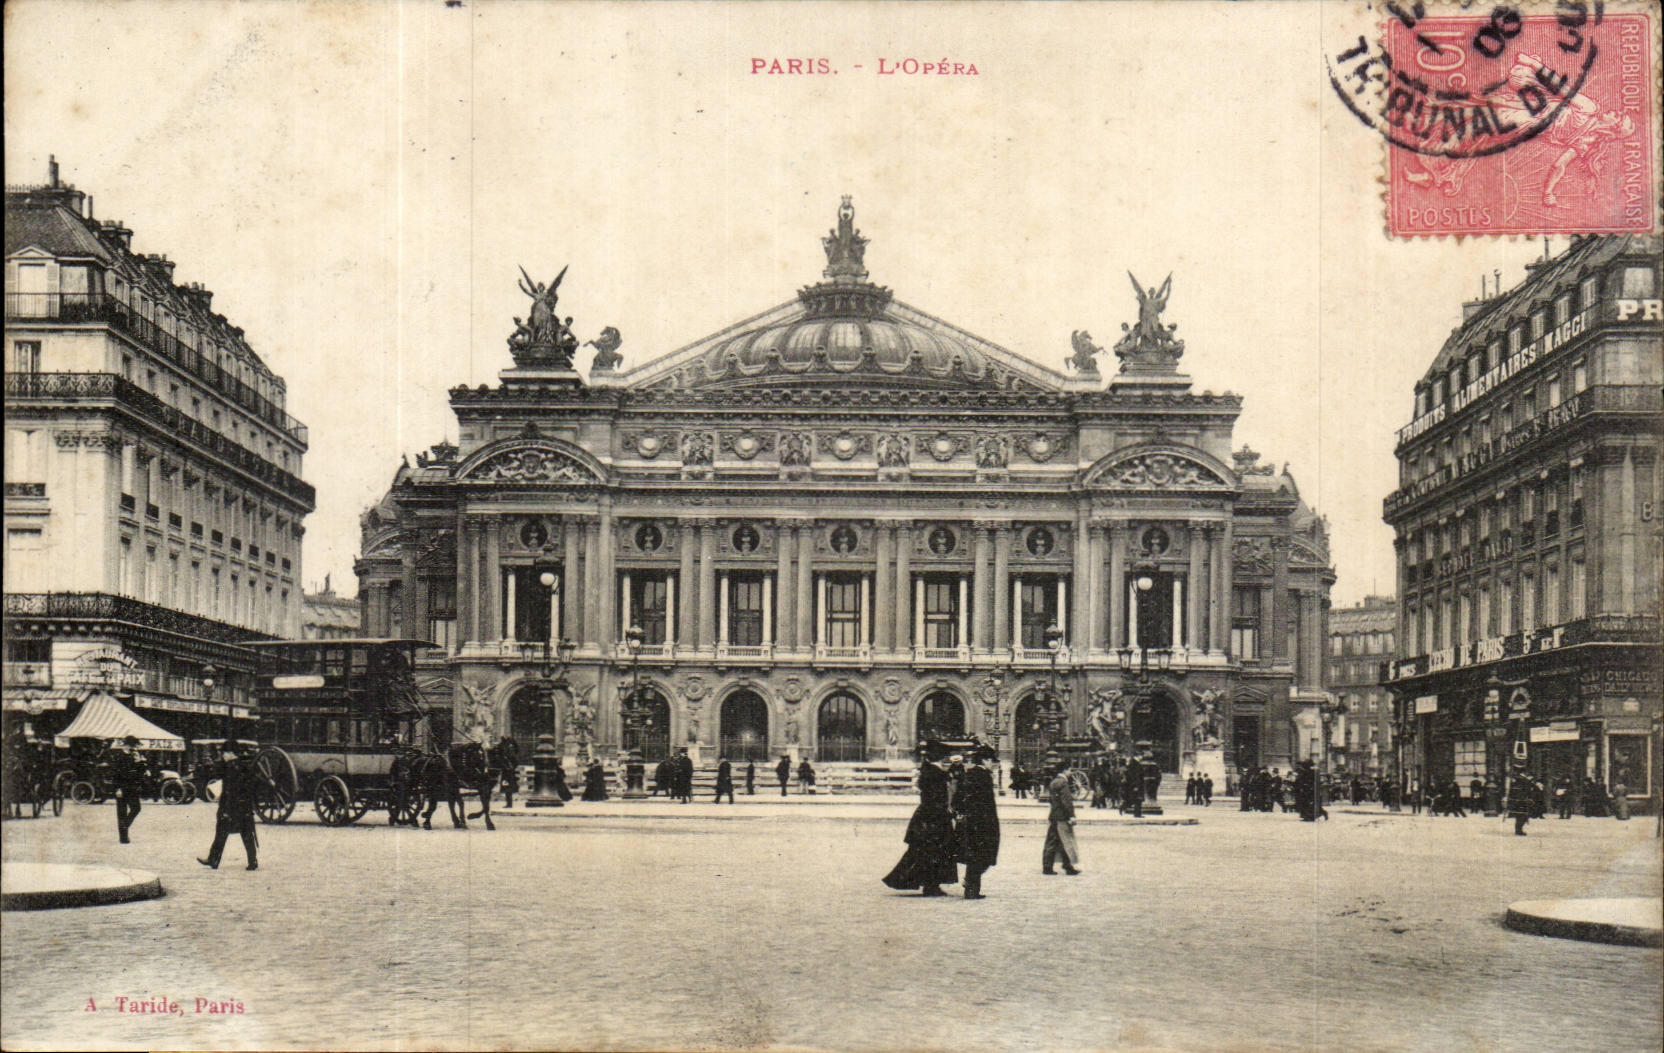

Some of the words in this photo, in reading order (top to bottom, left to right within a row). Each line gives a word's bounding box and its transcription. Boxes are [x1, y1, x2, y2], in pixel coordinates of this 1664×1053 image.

[1621, 23, 1640, 113] REPUBLIQUE
[1518, 64, 1568, 117] DE
[1409, 207, 1491, 226] POSTES
[1402, 403, 1446, 444] PRODUITS
[1453, 343, 1537, 414] ALIMENTAIRES
[1544, 311, 1587, 355] MAGGI
[1476, 636, 1505, 663] PARIS
[100, 663, 113, 671] DU
[117, 673, 145, 685] PAIX
